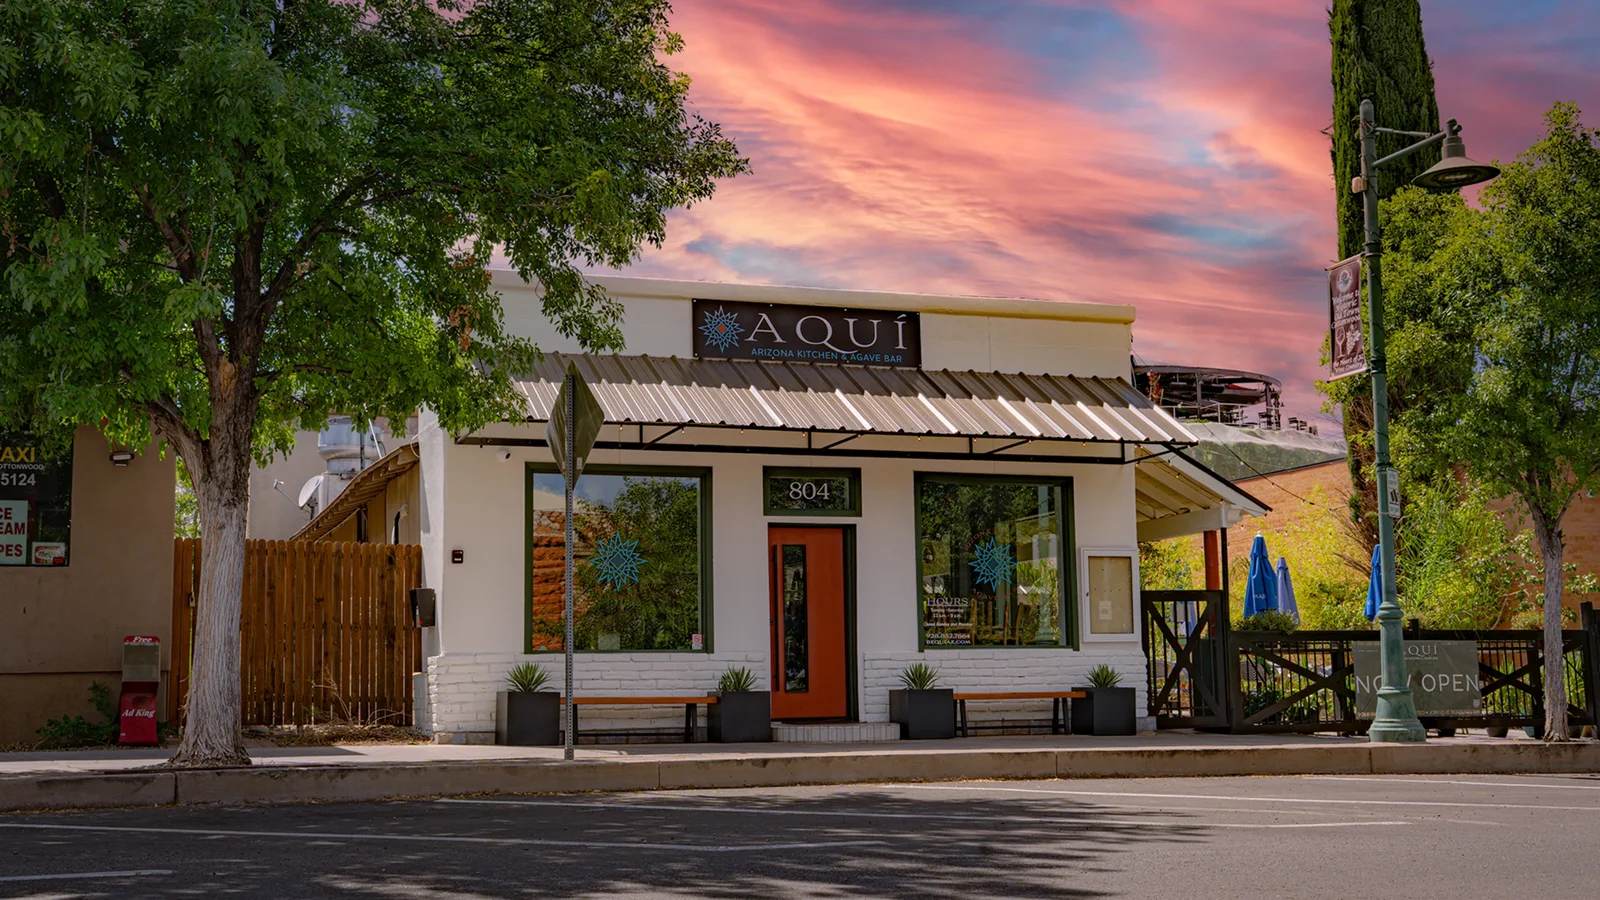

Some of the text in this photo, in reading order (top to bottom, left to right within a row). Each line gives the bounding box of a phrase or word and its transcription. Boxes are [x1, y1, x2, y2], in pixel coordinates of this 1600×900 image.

[744, 312, 907, 353] AQUÍ
[751, 347, 902, 363] ARIZONA KITCHEN & AGAVE BAR
[0, 447, 35, 463] AXI
[0, 473, 36, 486] 5124
[789, 481, 830, 500] 804
[927, 597, 968, 606] HOURS
[1403, 642, 1438, 657] QUÍ
[1356, 674, 1480, 694] NO OPEN
[122, 709, 155, 719] Ad King
